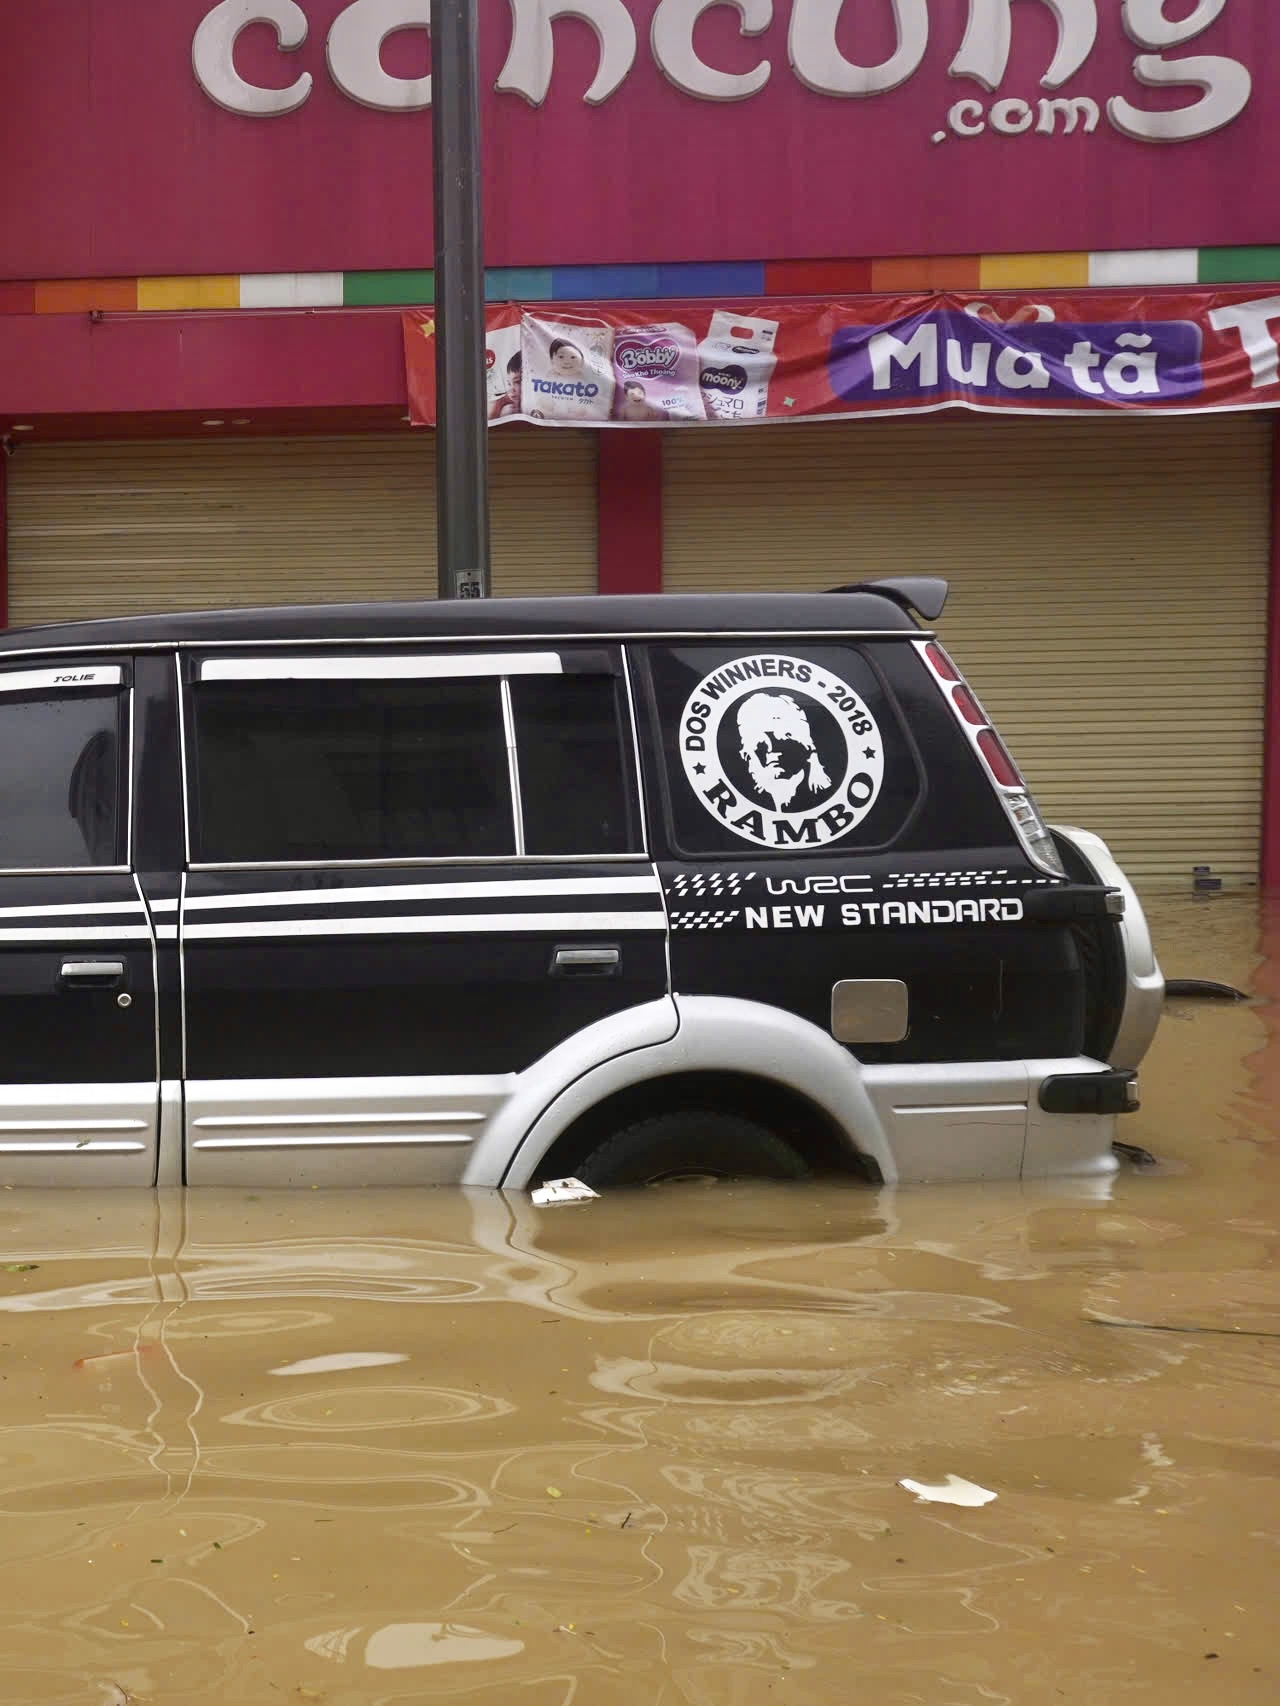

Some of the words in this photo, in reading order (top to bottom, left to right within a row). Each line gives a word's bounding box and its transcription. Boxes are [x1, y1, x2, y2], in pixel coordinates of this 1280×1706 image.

[930, 97, 1100, 144] .com
[621, 346, 677, 370] Bobby
[867, 323, 1051, 391] Mua
[1064, 332, 1161, 395] tã
[531, 378, 599, 398] Takato
[702, 372, 742, 390] moony
[685, 701, 712, 752] DOS
[700, 658, 812, 701] WINNERS
[827, 686, 873, 736] 2018
[703, 772, 874, 845] RAMBO
[765, 874, 873, 895] WRC
[745, 904, 826, 929] NEW
[840, 898, 1024, 927] STANDARD
